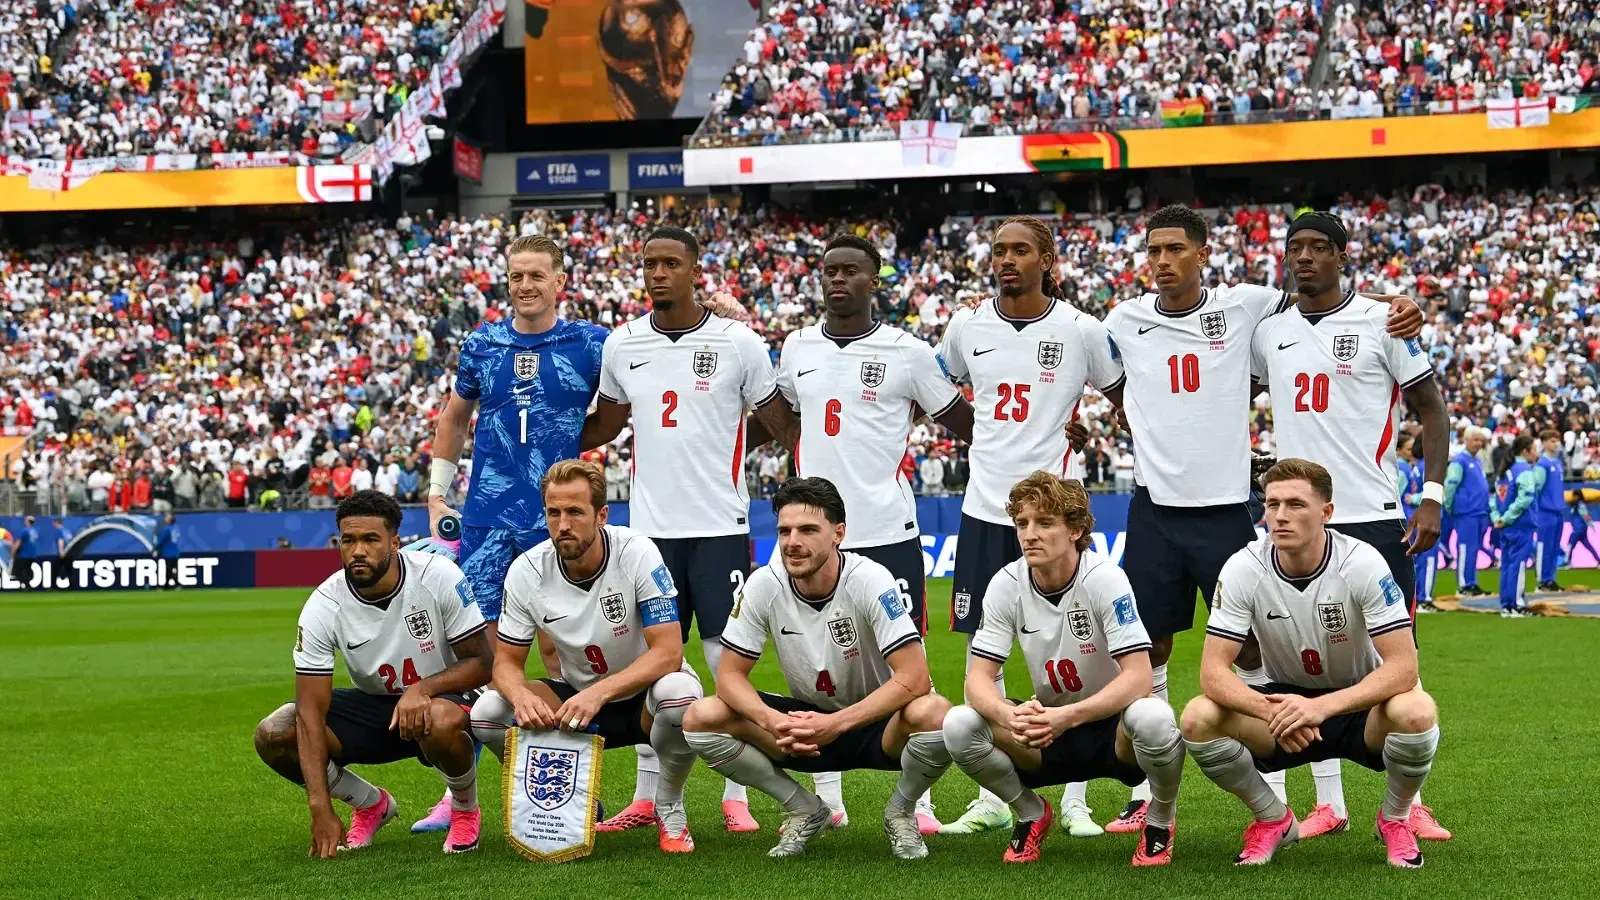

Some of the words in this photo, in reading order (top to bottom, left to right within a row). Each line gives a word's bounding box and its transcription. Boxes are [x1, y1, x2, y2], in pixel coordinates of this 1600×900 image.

[548, 163, 577, 174] FIFA
[548, 175, 577, 184] STORE
[638, 164, 669, 177] FIFA
[1168, 354, 1200, 394] 10
[1294, 372, 1330, 412] 20
[662, 390, 678, 428] 2
[824, 398, 842, 436] 6
[994, 382, 1031, 422] 25
[518, 408, 528, 444] 1
[649, 602, 673, 612] UNITES
[896, 578, 914, 614] 6
[378, 658, 422, 694] 24
[584, 644, 608, 674] 9
[1044, 658, 1084, 694] 18
[1301, 649, 1324, 676] 8
[816, 670, 836, 698] 4
